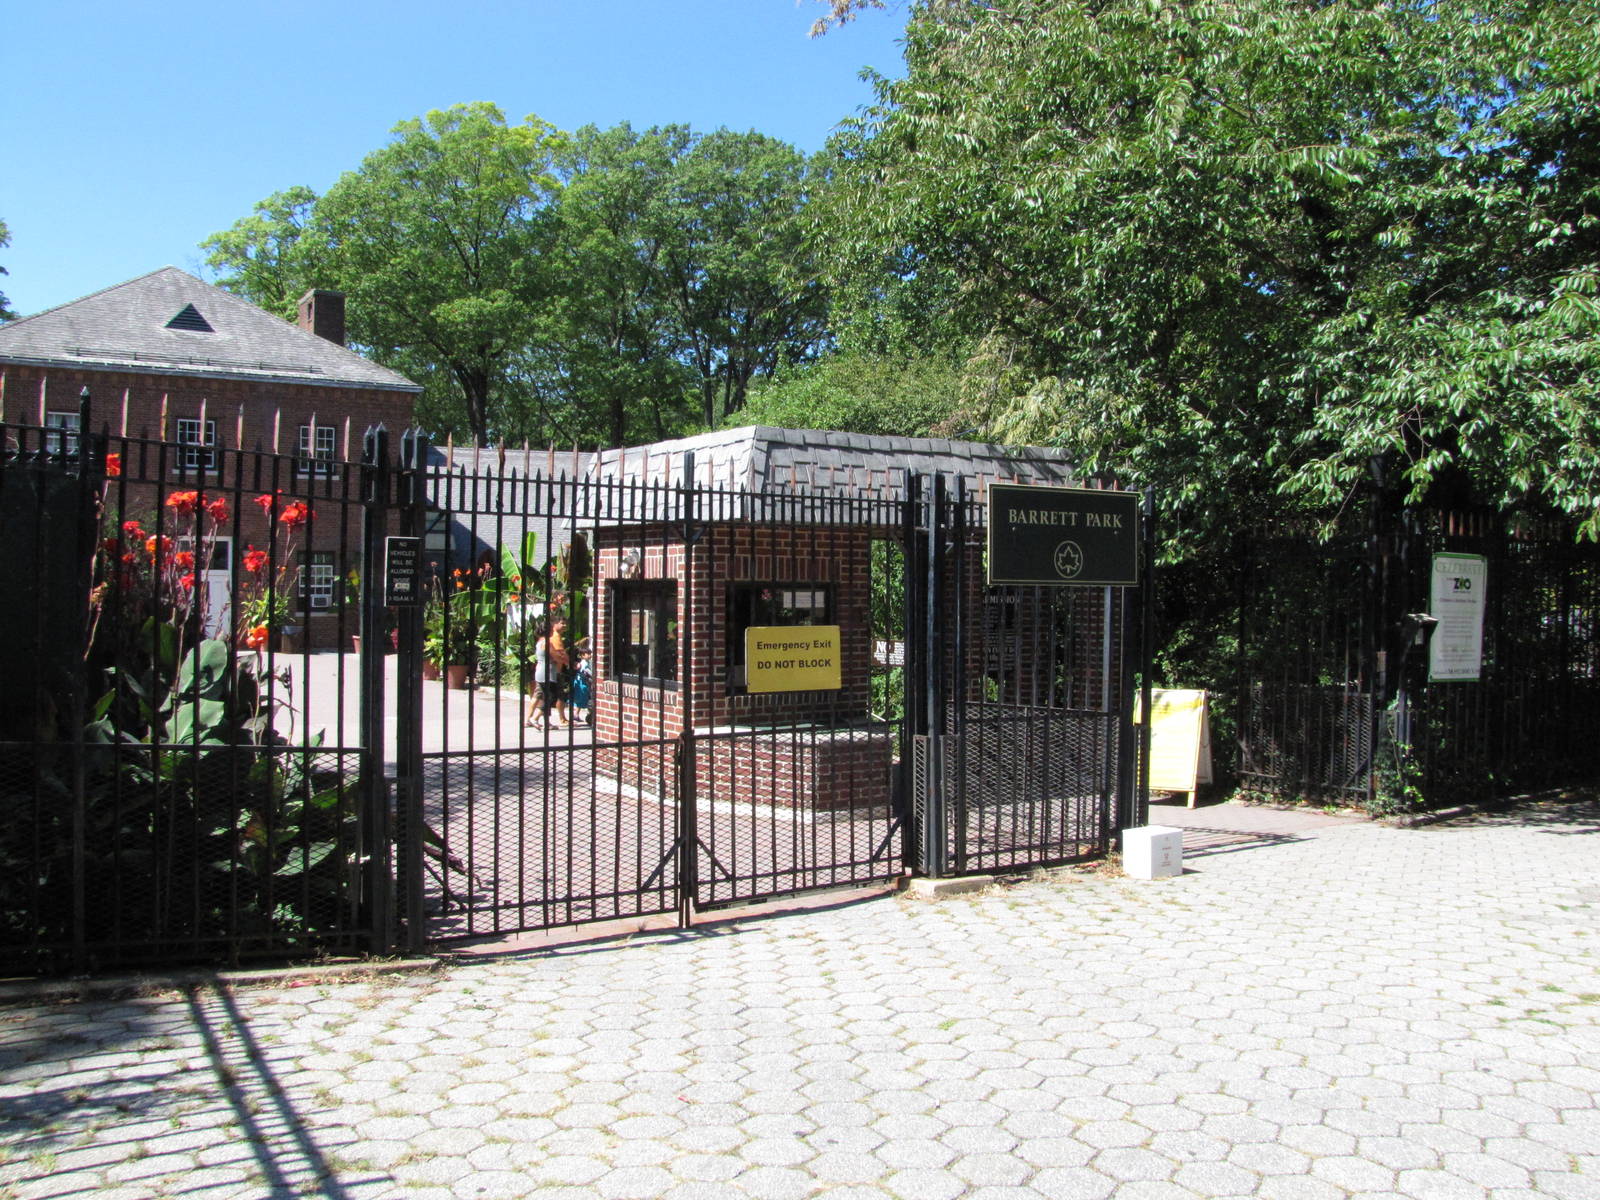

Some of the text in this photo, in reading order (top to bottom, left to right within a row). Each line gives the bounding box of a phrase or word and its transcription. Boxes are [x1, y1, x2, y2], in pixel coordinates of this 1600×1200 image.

[1008, 509, 1123, 528] BARRETT PARK
[756, 640, 832, 651] Emergency Exit
[757, 659, 832, 670] DO NOT BLOCK
